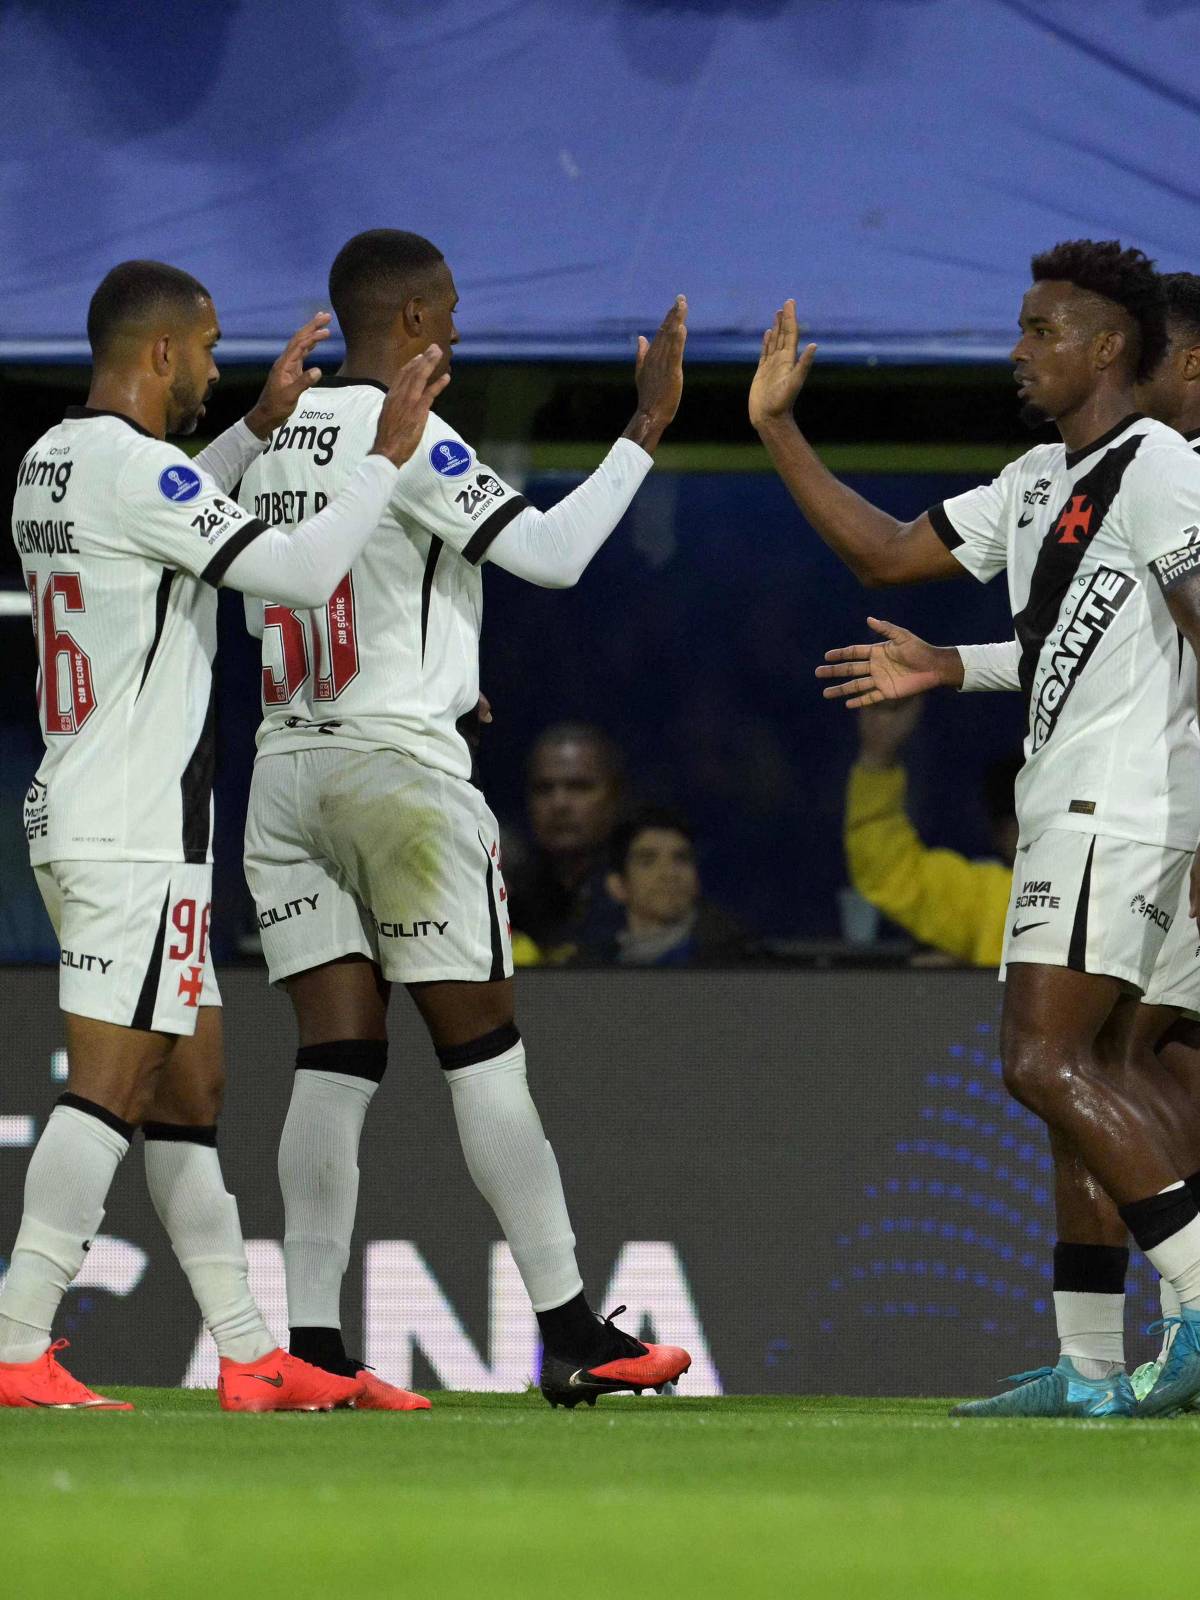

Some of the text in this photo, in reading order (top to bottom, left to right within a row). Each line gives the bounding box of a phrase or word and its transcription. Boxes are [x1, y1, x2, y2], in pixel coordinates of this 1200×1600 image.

[300, 409, 334, 420] banco
[273, 423, 341, 466] bmg
[25, 452, 73, 503] bmg
[455, 485, 487, 514] Zé
[471, 498, 494, 521] DELIVERY
[190, 508, 224, 537] Zé
[16, 520, 80, 558] HENRIQUE
[336, 597, 346, 628] SCORE
[75, 653, 84, 685] SCORE
[1035, 571, 1125, 750] GIGANTE
[1015, 895, 1061, 909] SORTE
[1022, 881, 1051, 893] VIVA
